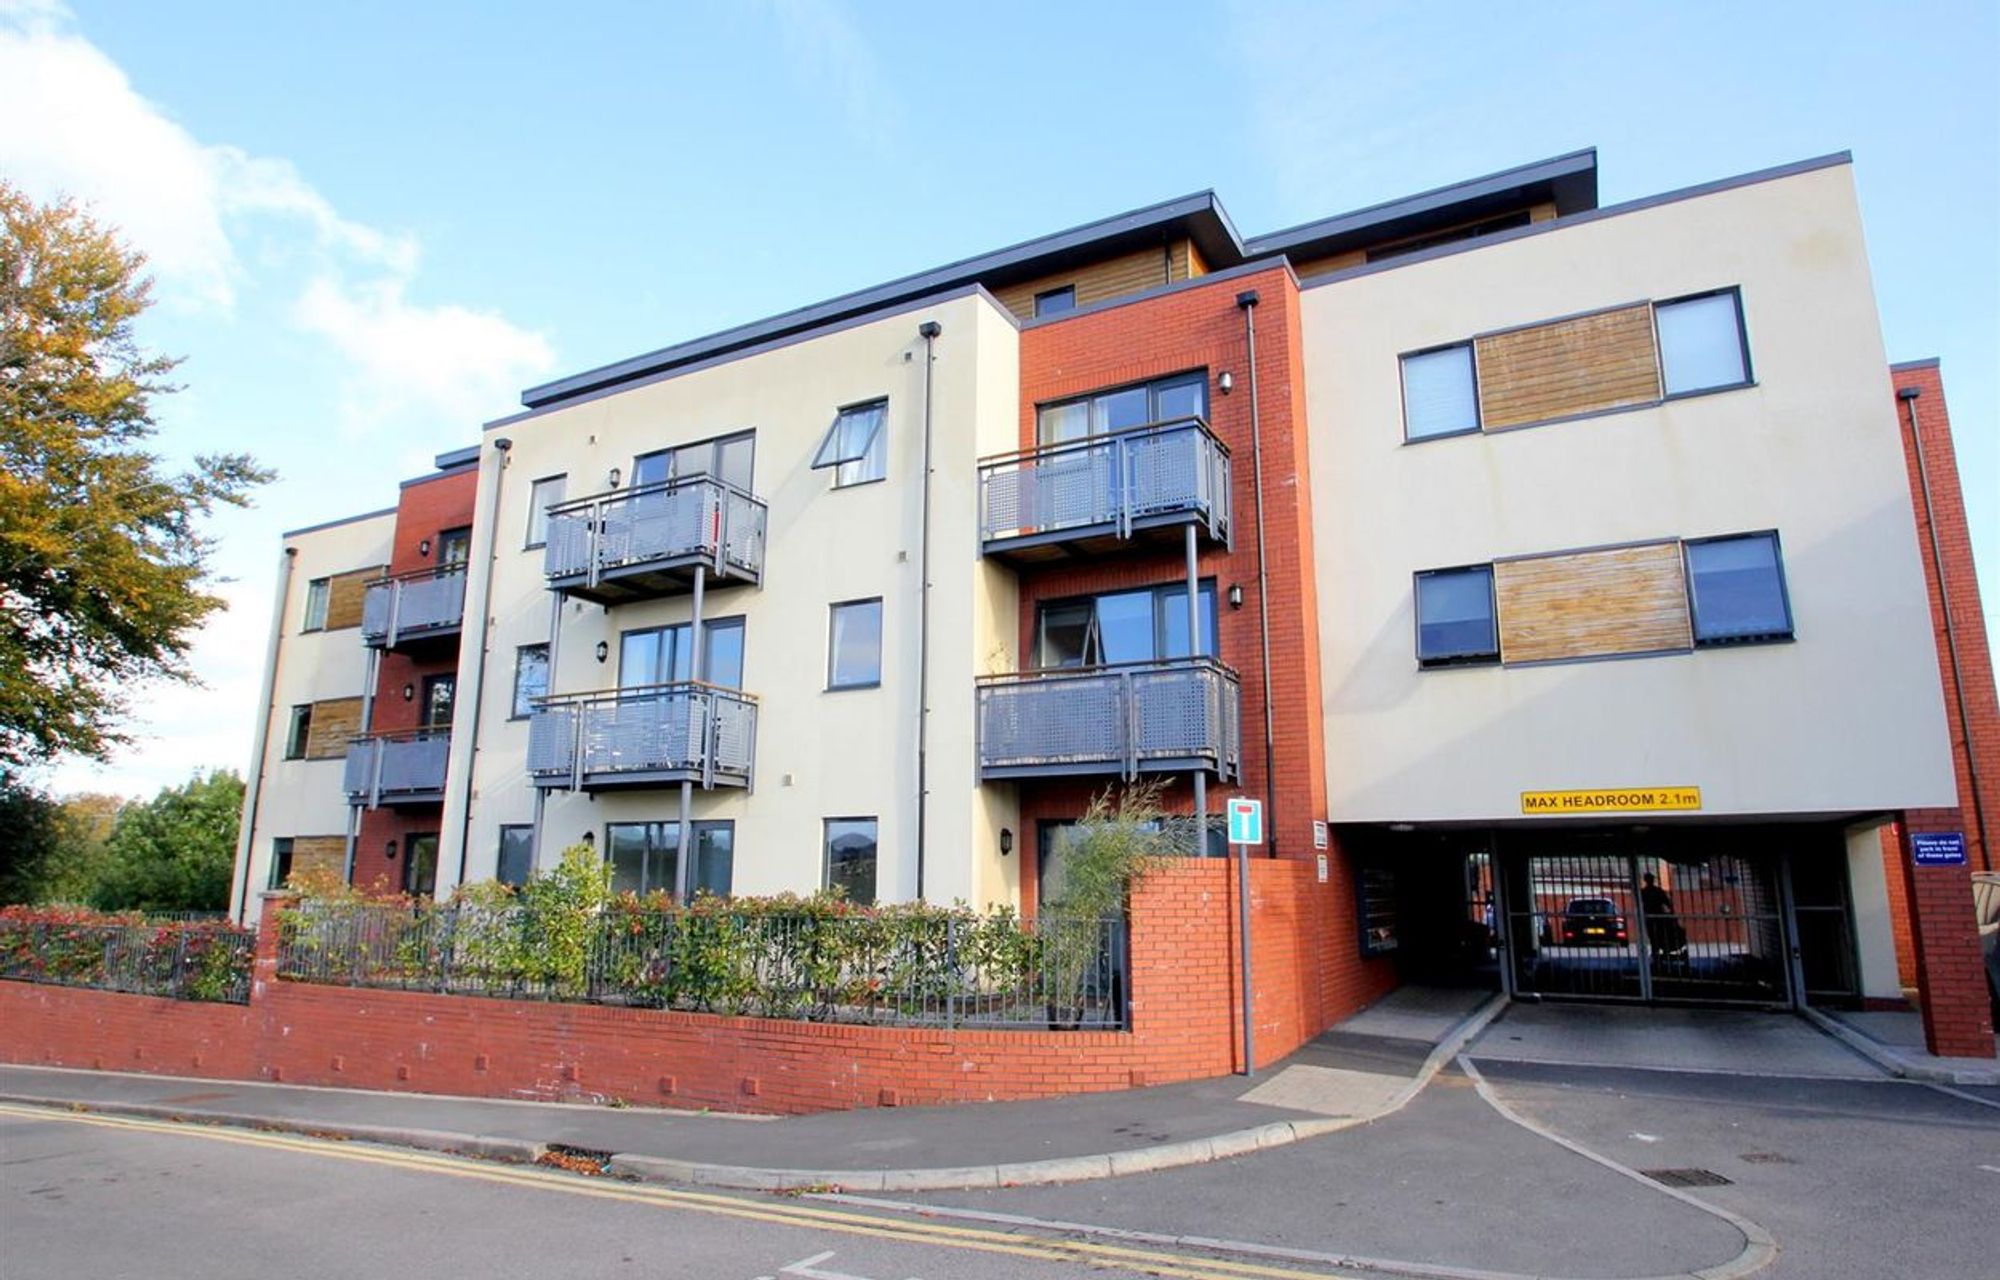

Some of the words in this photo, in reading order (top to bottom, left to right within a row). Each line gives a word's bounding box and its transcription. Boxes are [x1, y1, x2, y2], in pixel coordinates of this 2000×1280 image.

[1525, 797, 1558, 808] MAX
[1563, 794, 1654, 807] HEADROOM
[1660, 793, 1697, 805] 2.1m
